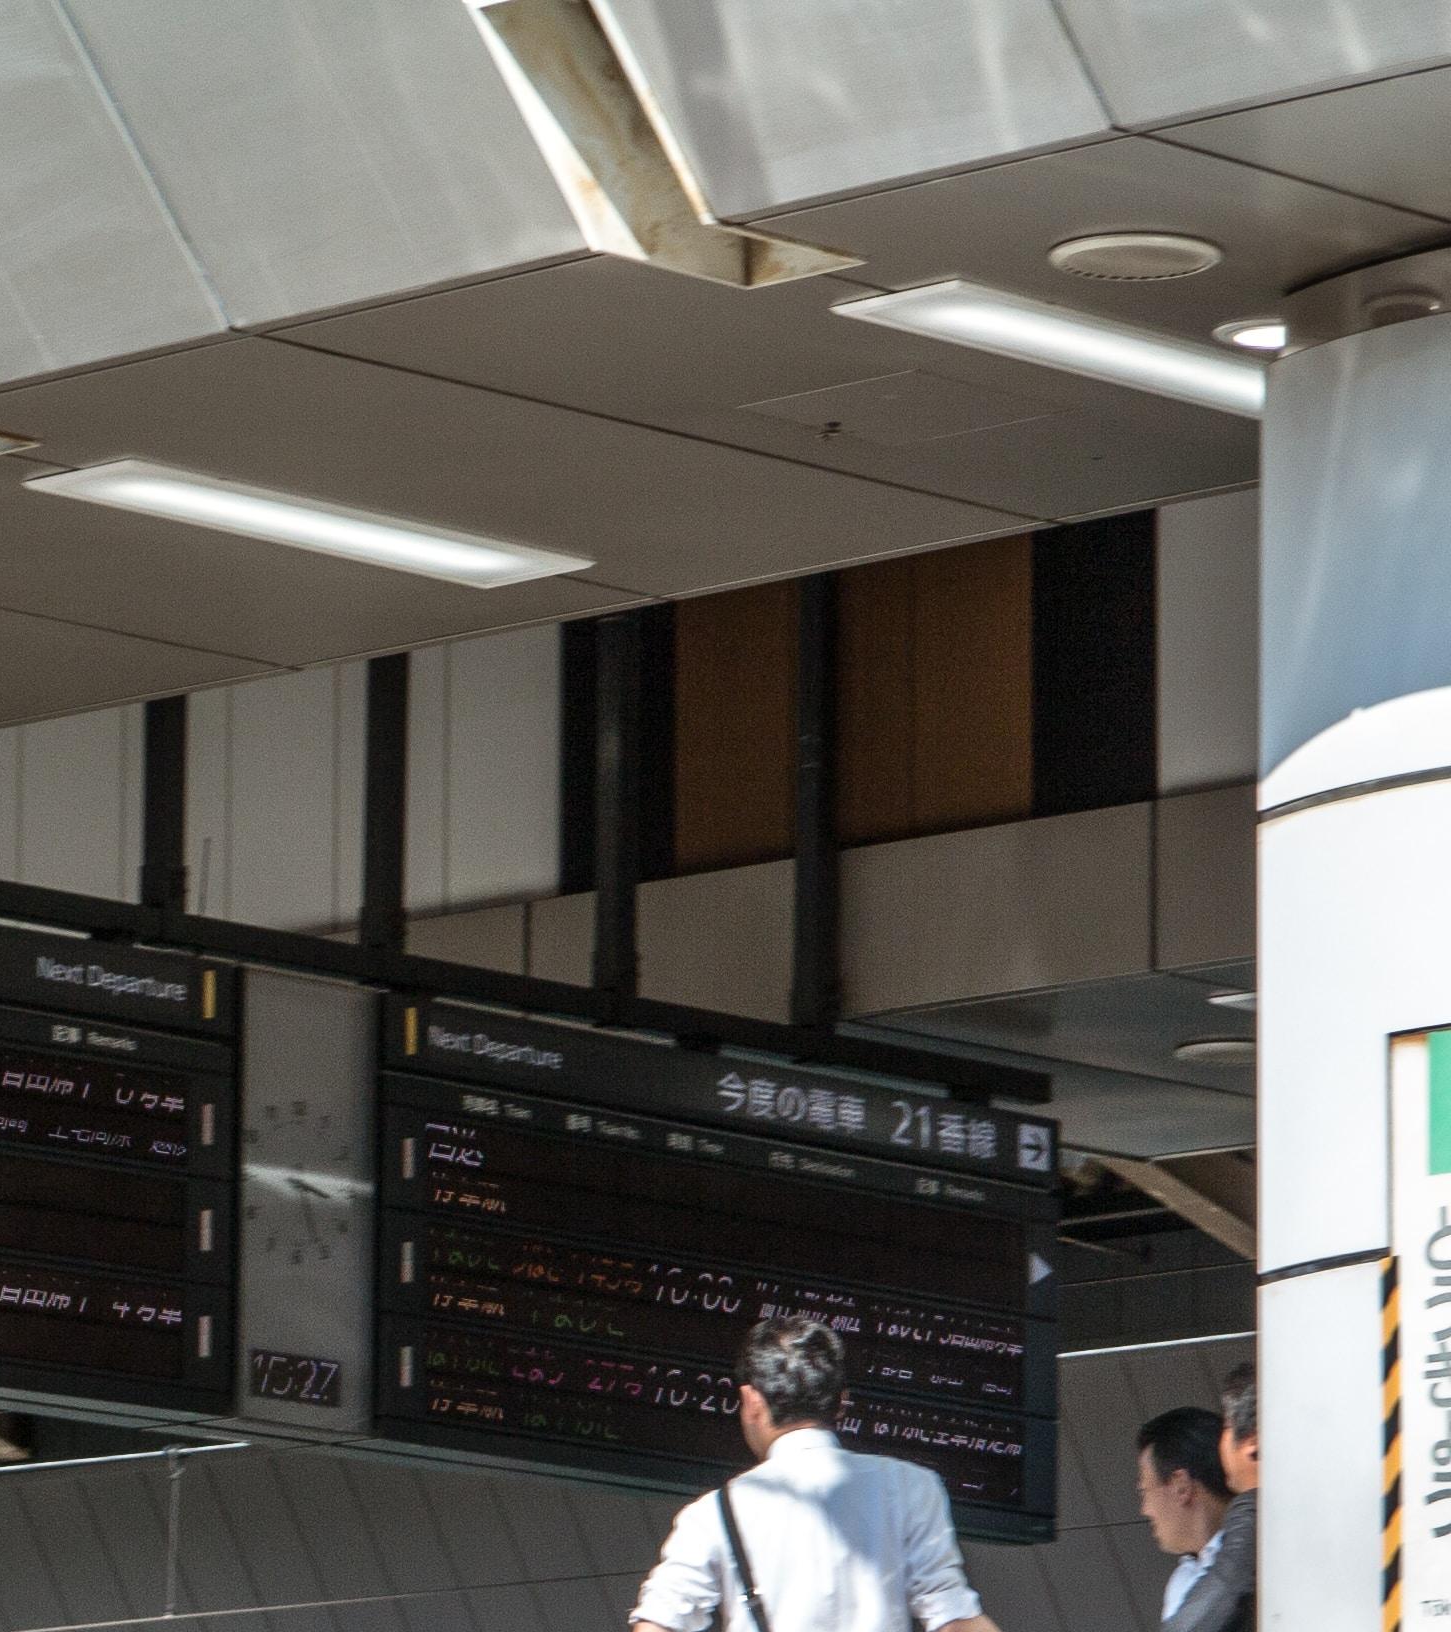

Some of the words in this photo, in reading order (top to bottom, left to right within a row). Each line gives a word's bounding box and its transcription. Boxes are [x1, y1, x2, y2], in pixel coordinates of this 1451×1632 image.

[36, 956, 84, 986] Next
[87, 964, 188, 1001] Departure
[890, 1099, 998, 1160] 21番線
[252, 1354, 340, 1401] 15:27
